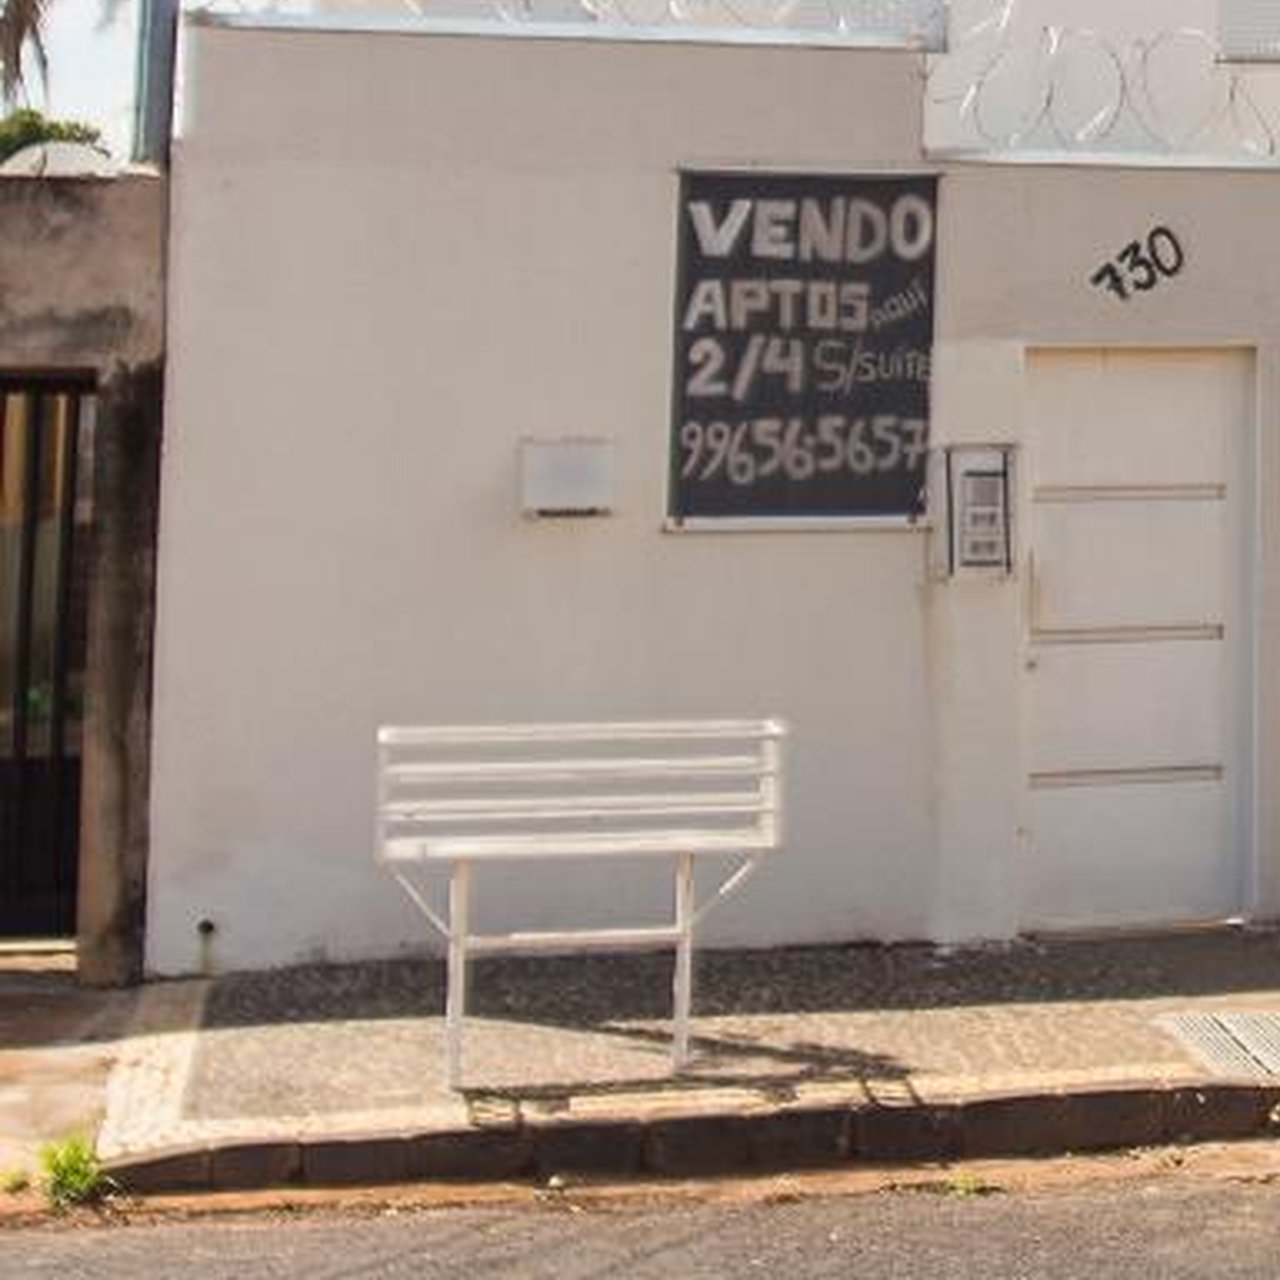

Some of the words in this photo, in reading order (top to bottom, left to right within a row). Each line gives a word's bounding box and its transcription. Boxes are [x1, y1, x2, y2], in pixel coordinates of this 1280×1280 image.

[689, 195, 932, 264] VENDO
[1090, 226, 1184, 300] 730
[683, 279, 871, 332] APTOS
[686, 335, 803, 401] 2/4
